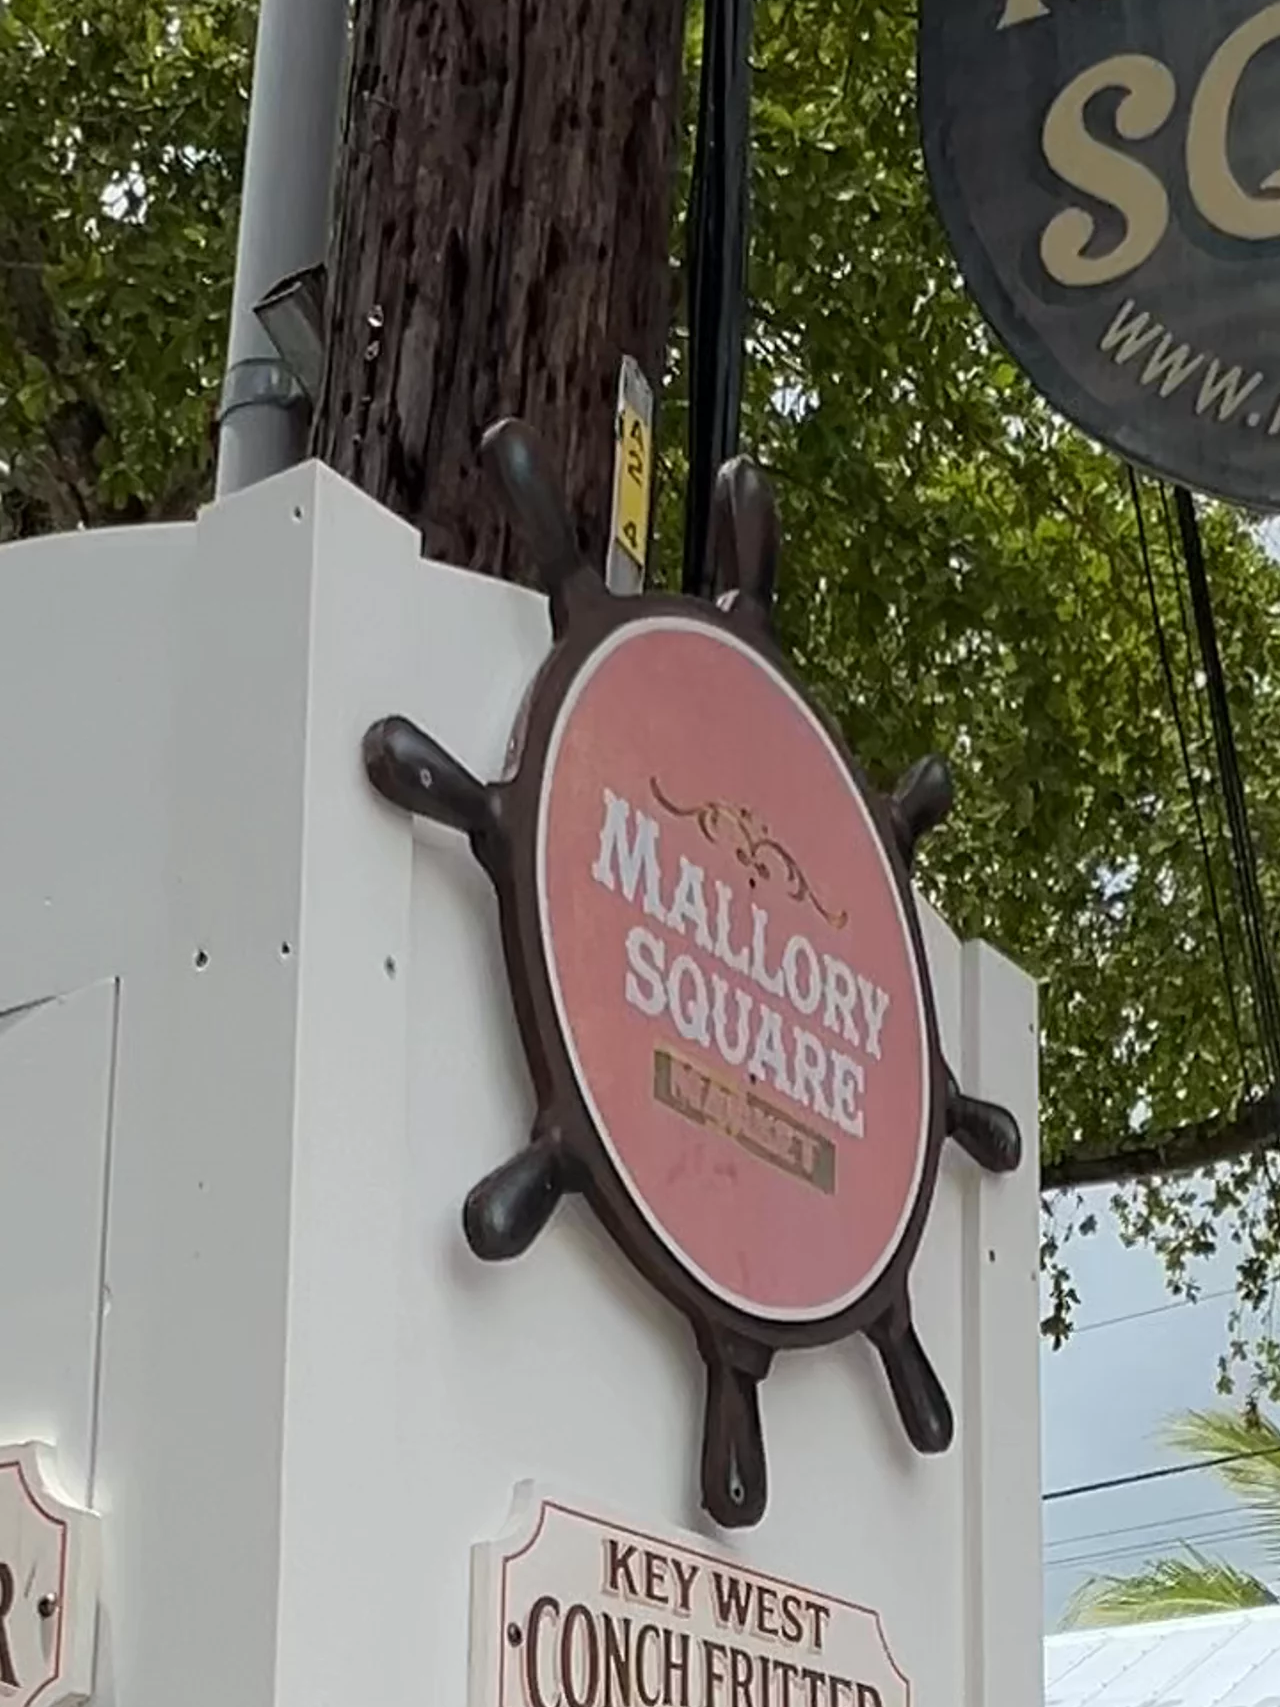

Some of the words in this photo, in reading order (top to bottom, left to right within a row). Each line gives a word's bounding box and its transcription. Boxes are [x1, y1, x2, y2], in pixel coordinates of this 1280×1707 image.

[592, 788, 890, 1061] MALLORY
[625, 930, 865, 1139] SQUARE
[604, 1540, 701, 1610] KEY
[712, 1571, 829, 1649] WEST
